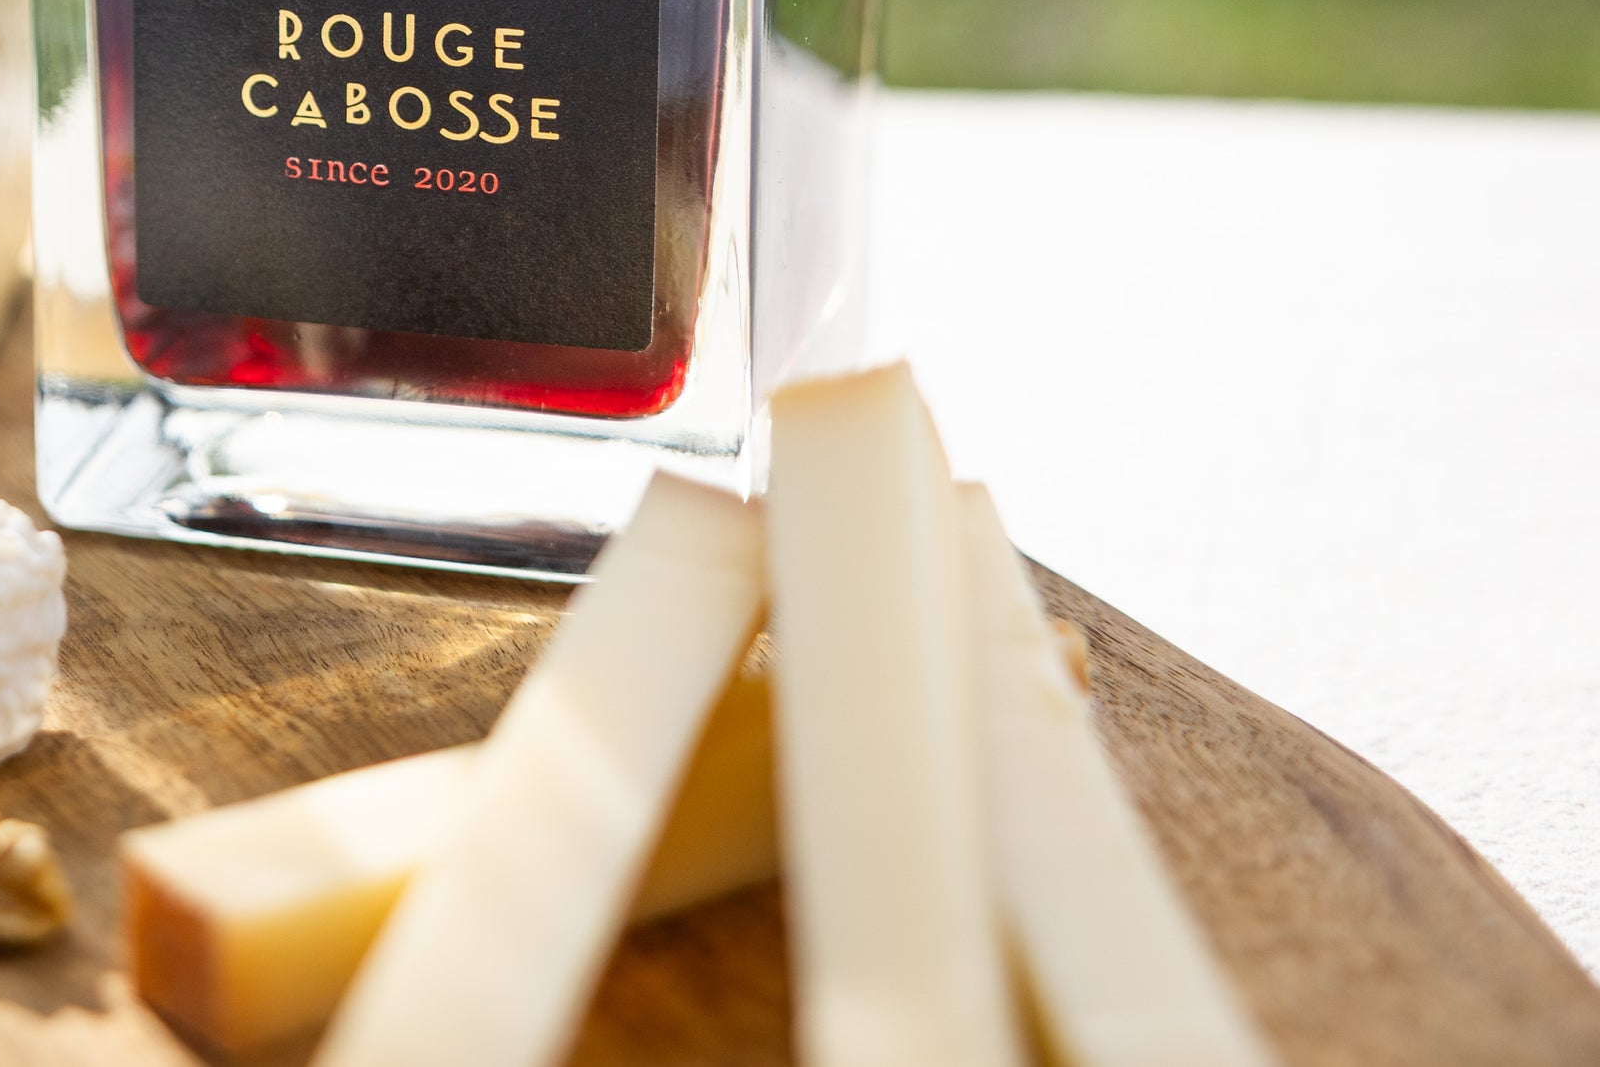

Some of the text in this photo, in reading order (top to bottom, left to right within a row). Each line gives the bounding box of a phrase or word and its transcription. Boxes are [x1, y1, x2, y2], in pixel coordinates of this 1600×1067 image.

[278, 9, 526, 72] ROUGE
[241, 73, 561, 145] CABOSSE
[414, 167, 501, 195] 2020
